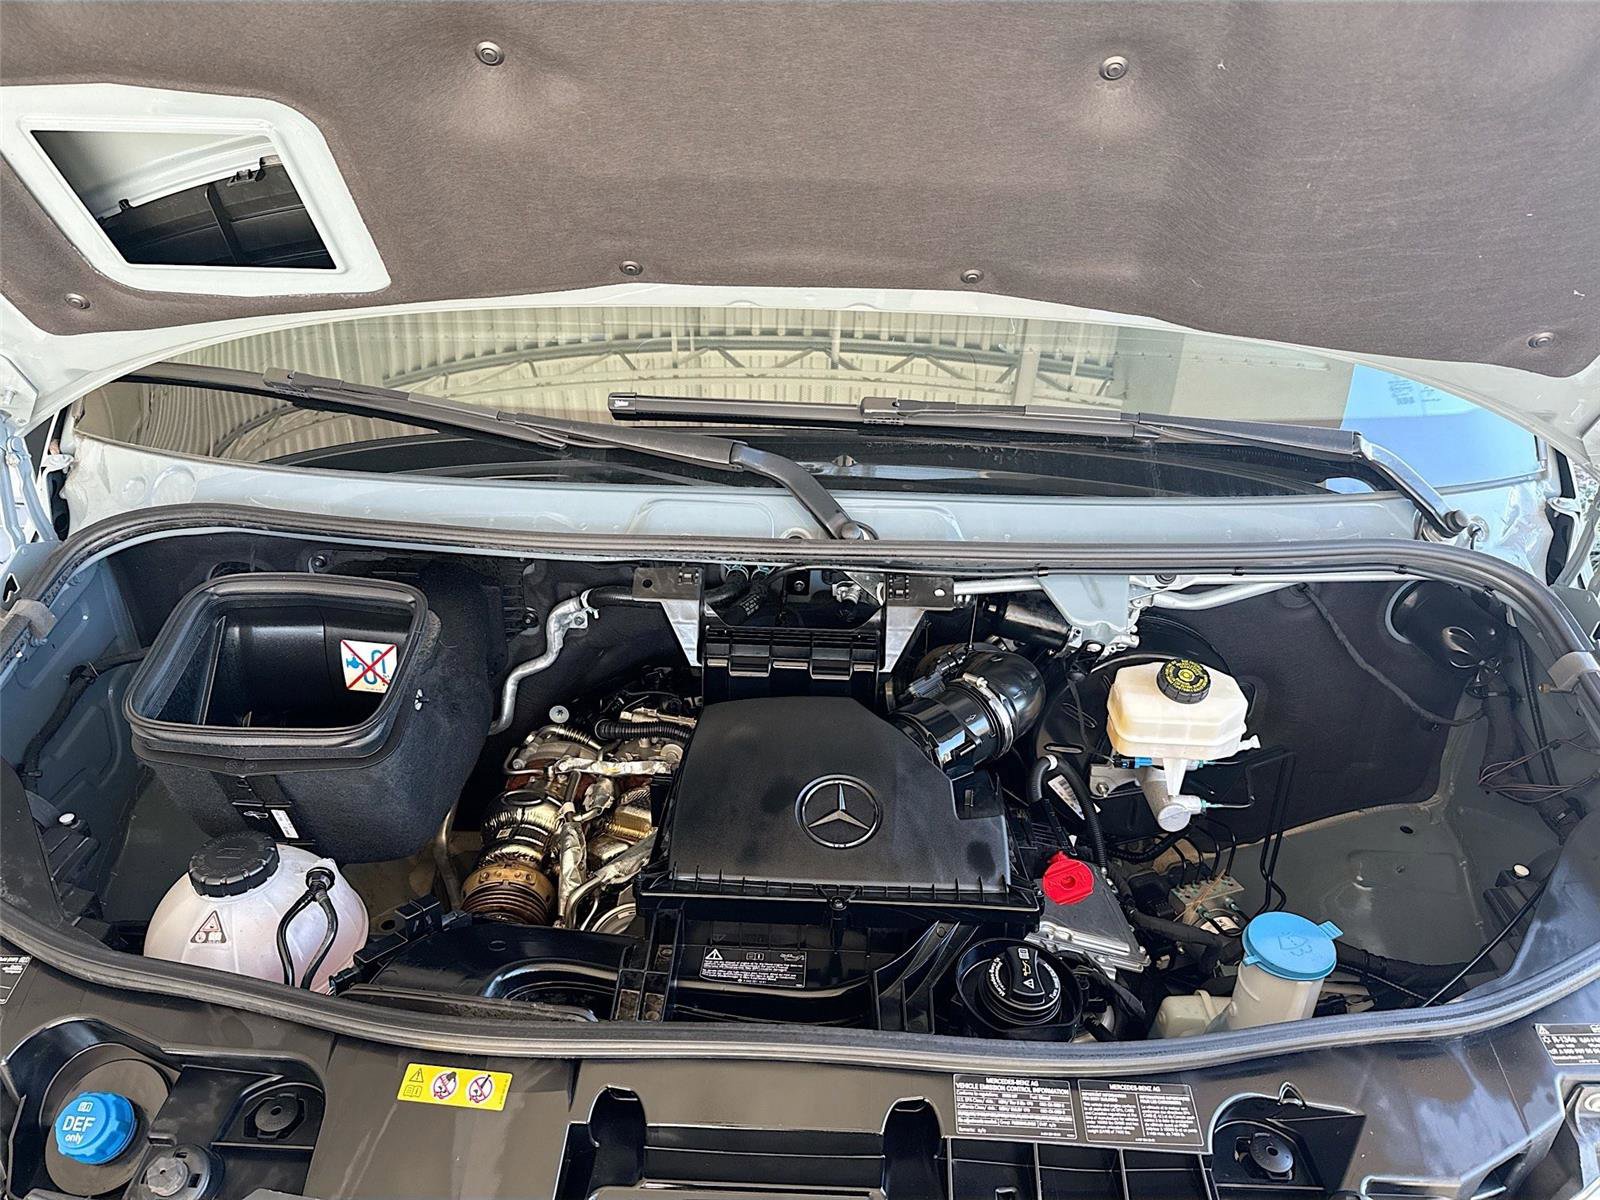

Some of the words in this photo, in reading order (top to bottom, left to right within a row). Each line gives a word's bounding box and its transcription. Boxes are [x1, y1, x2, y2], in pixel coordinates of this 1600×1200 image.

[986, 1077, 1030, 1087] MERCEDES-BENZ
[1109, 1083, 1151, 1092] MERCEDES-BENZ
[62, 1115, 96, 1132] DEF
[64, 1133, 83, 1145] only
